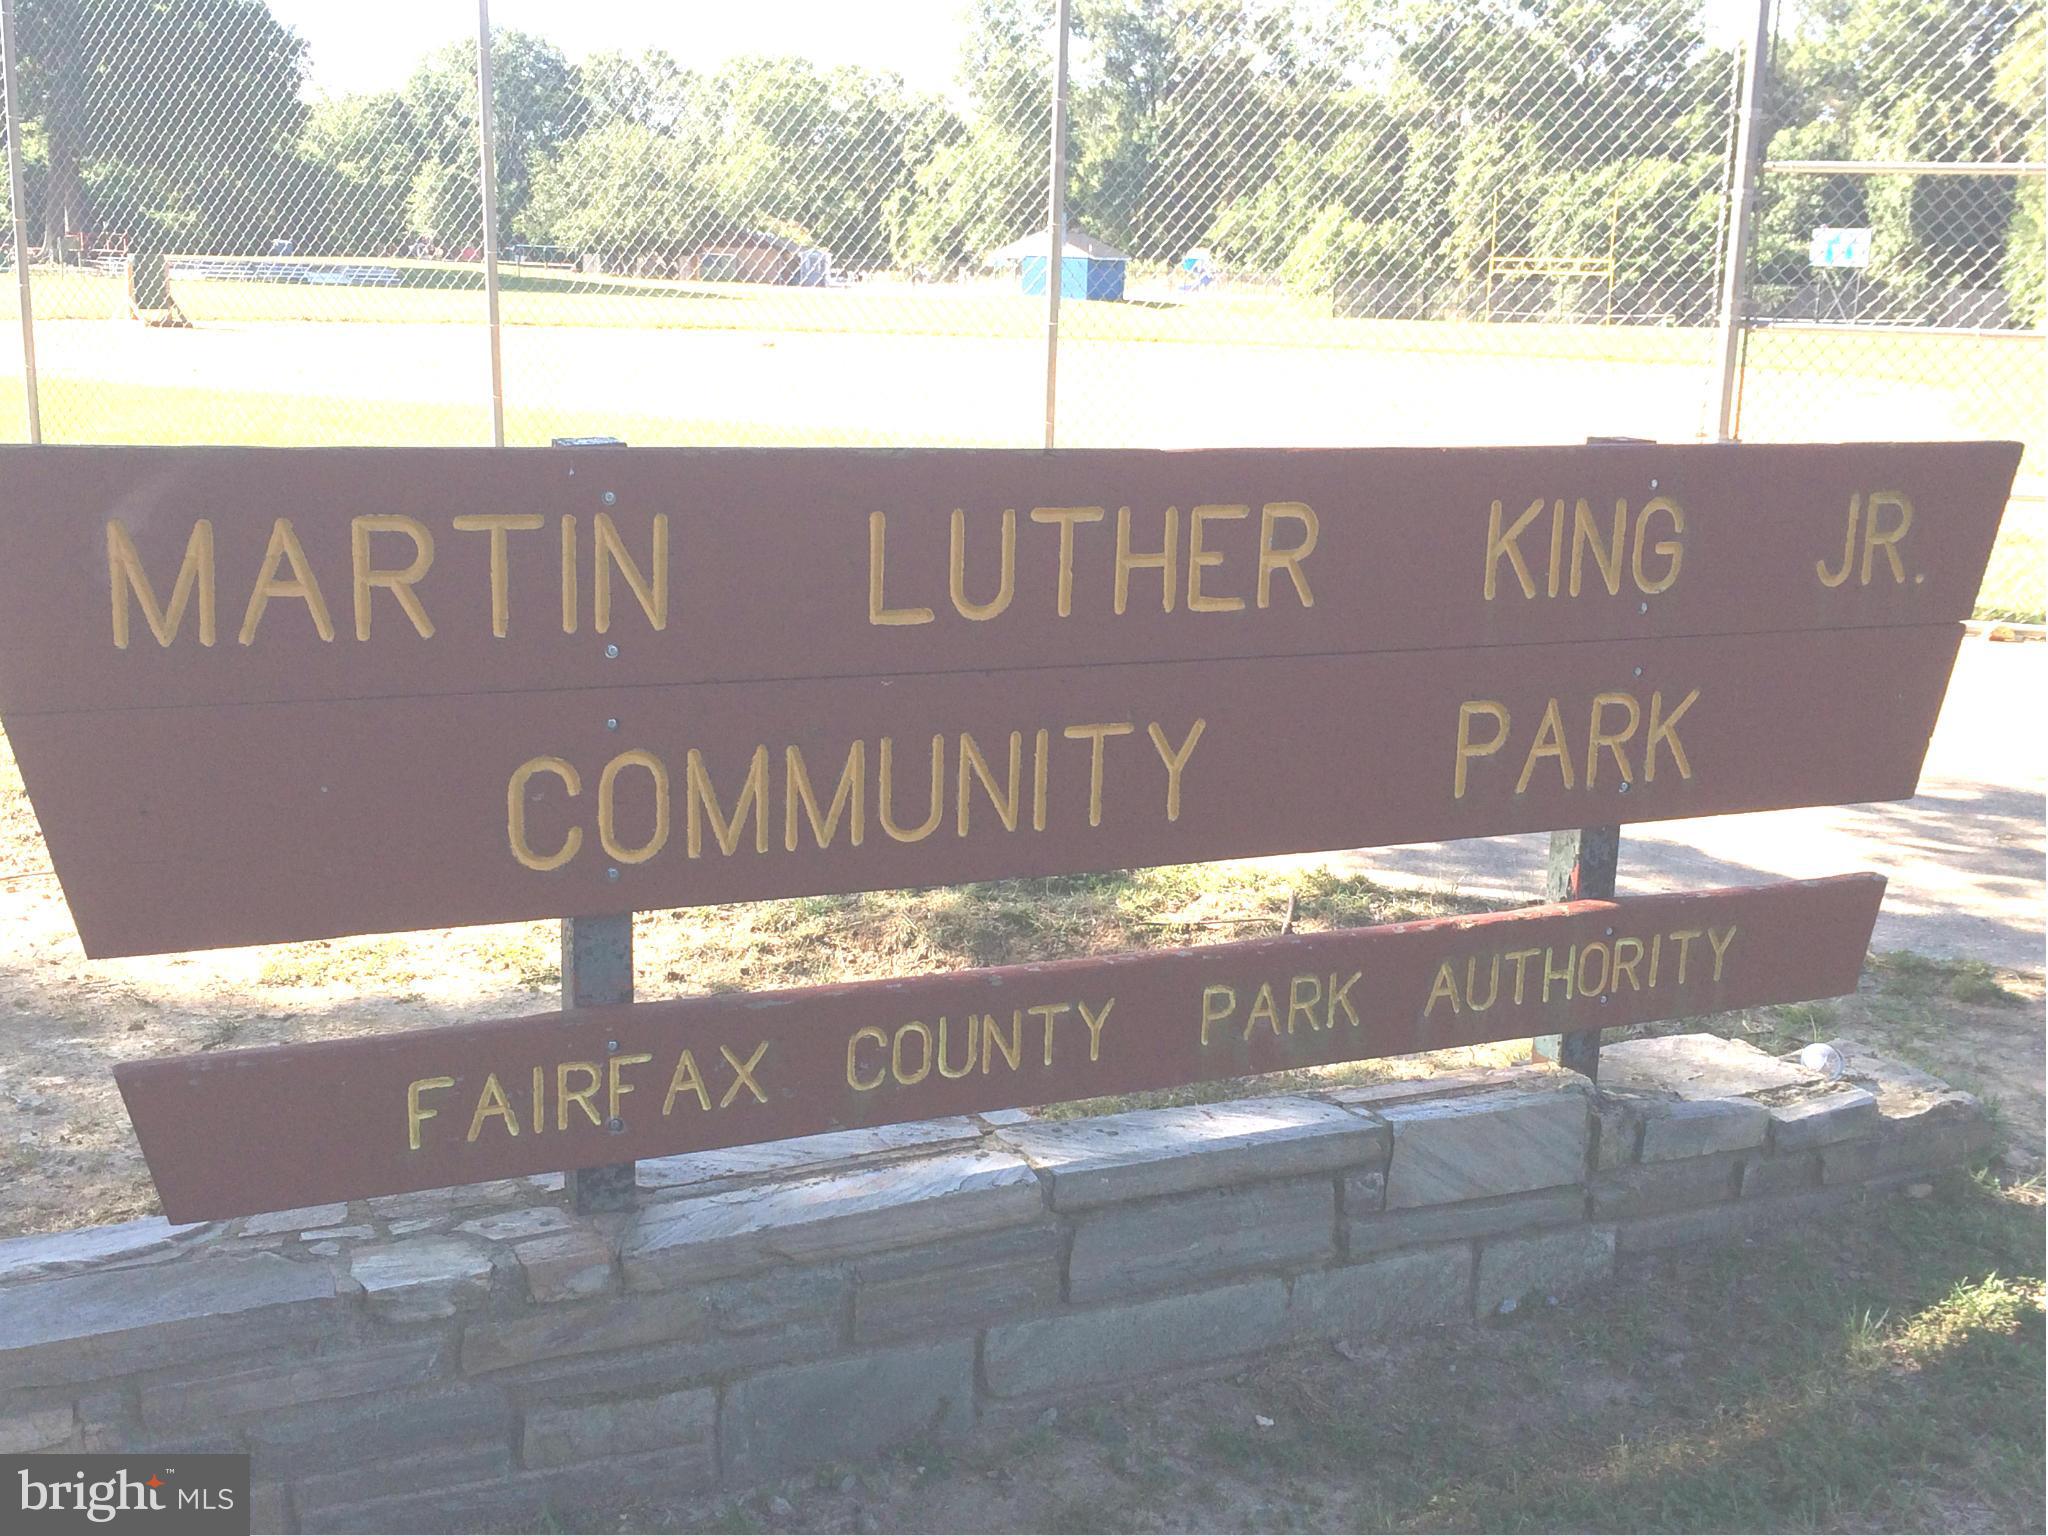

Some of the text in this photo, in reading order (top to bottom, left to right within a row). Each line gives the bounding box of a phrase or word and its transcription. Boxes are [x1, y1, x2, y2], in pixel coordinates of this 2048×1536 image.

[107, 491, 1925, 649] MARTIN LUTHER KING JR.
[508, 689, 1700, 870] COMMUNITY PARK
[408, 925, 1736, 1150] FAIRFAX COUNTY PARK AUTHORITY
